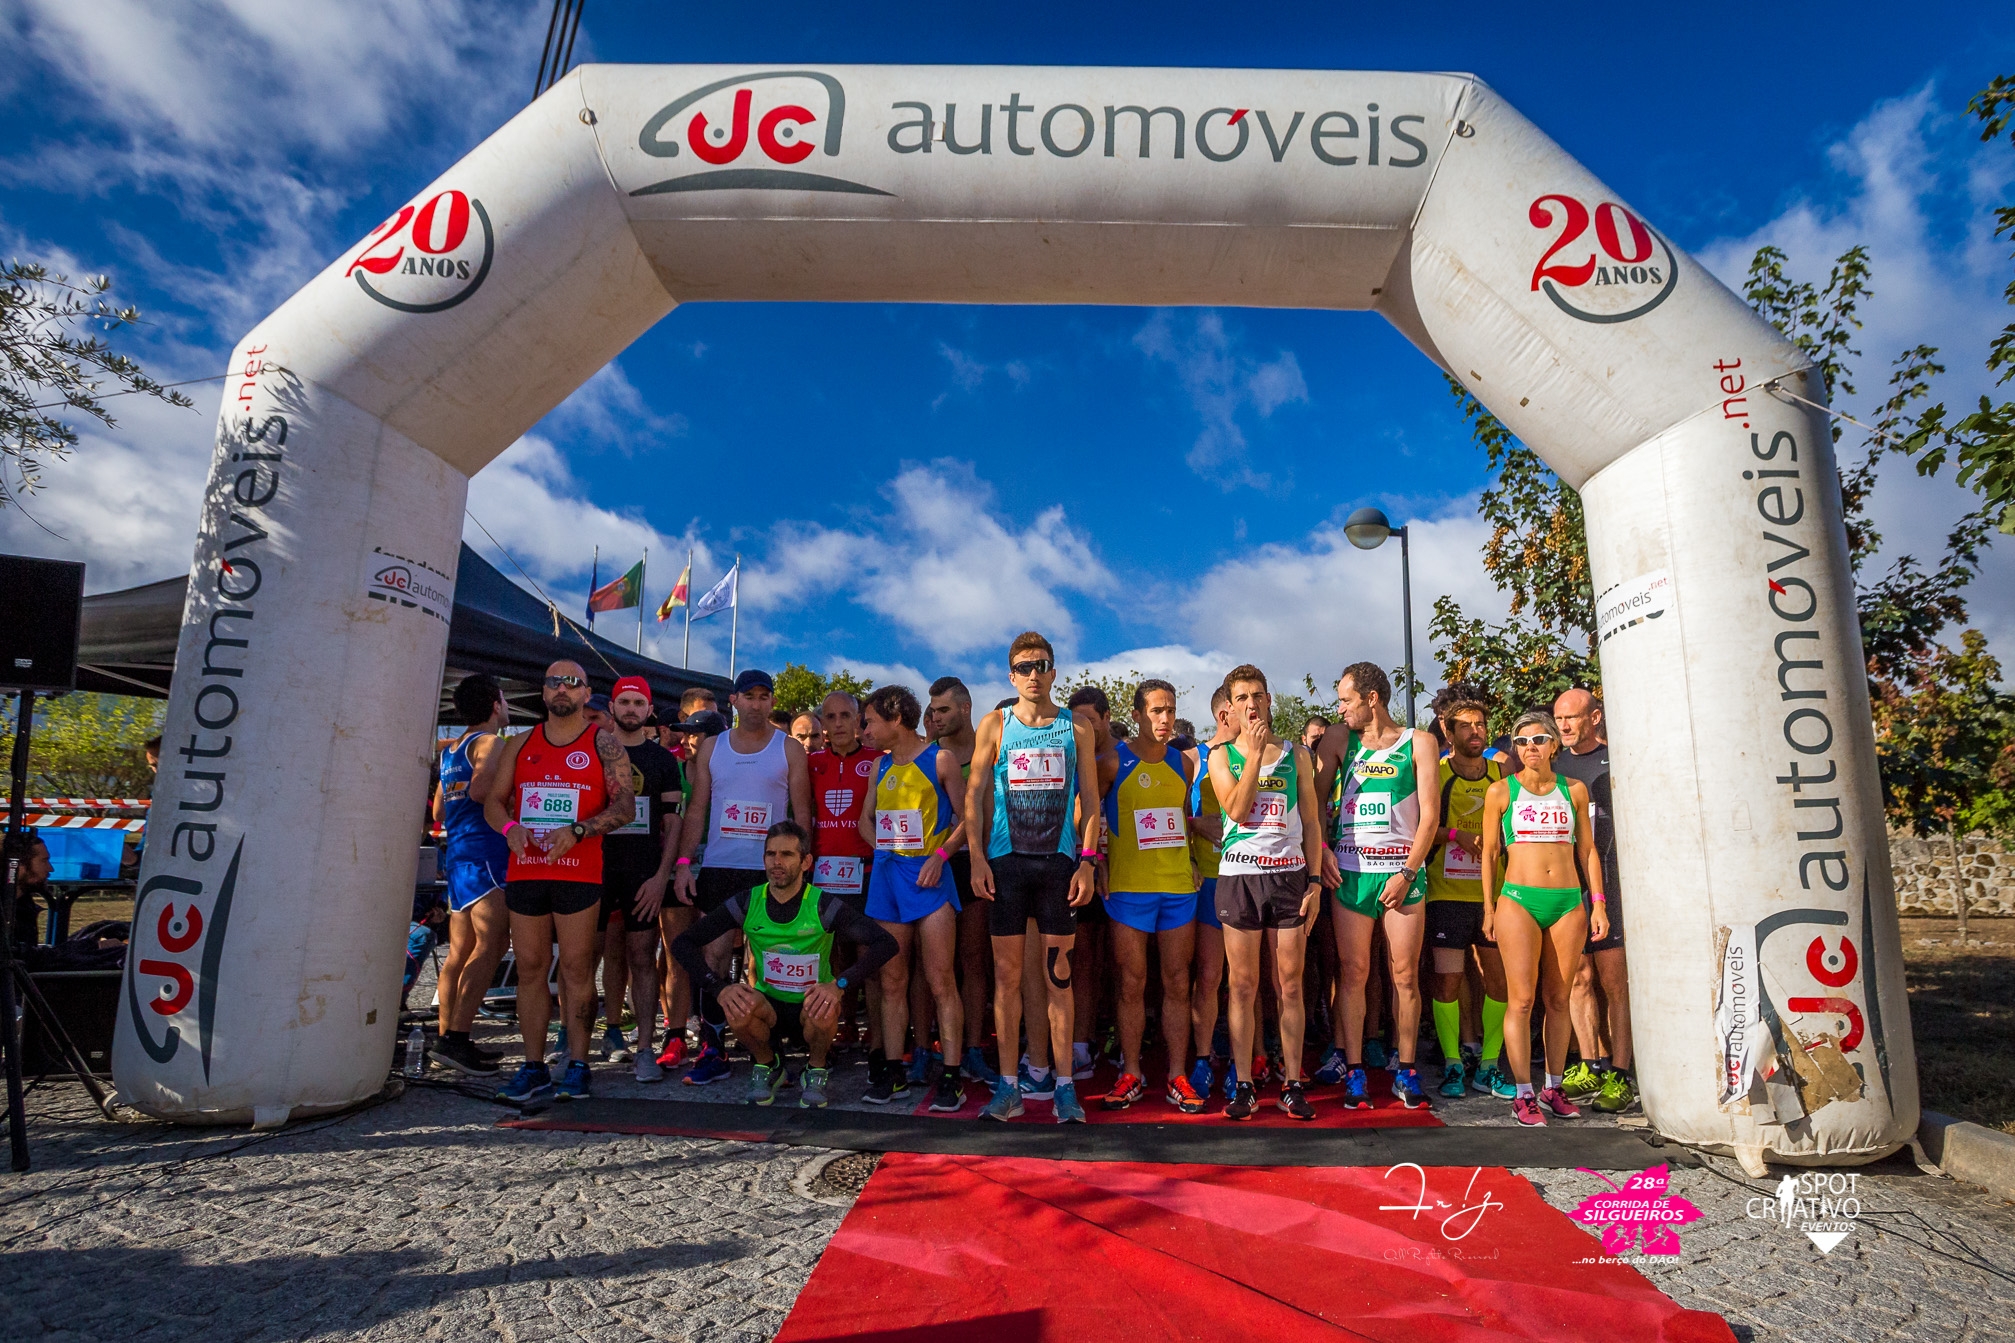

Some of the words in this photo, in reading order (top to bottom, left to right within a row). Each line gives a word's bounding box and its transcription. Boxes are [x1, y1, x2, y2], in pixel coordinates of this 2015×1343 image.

[887, 91, 1429, 168] automóveis
[345, 190, 471, 277] 20
[1528, 194, 1653, 292] 20
[401, 256, 471, 281] ANOS
[1595, 265, 1664, 287] ANOS
[1713, 357, 1750, 430] .net
[171, 414, 288, 863] automóveis
[238, 343, 268, 412] .net
[1743, 430, 1850, 892] automóveis
[1043, 758, 1050, 772] 1
[1365, 765, 1394, 775] NAPO
[543, 798, 572, 813] 688
[1260, 803, 1285, 817] 207
[1359, 802, 1386, 816] 690
[744, 811, 767, 824] 167
[1167, 817, 1175, 831] 6
[1540, 811, 1568, 825] 216
[900, 820, 908, 833] 5
[837, 866, 854, 879] 47
[786, 964, 813, 977] 251
